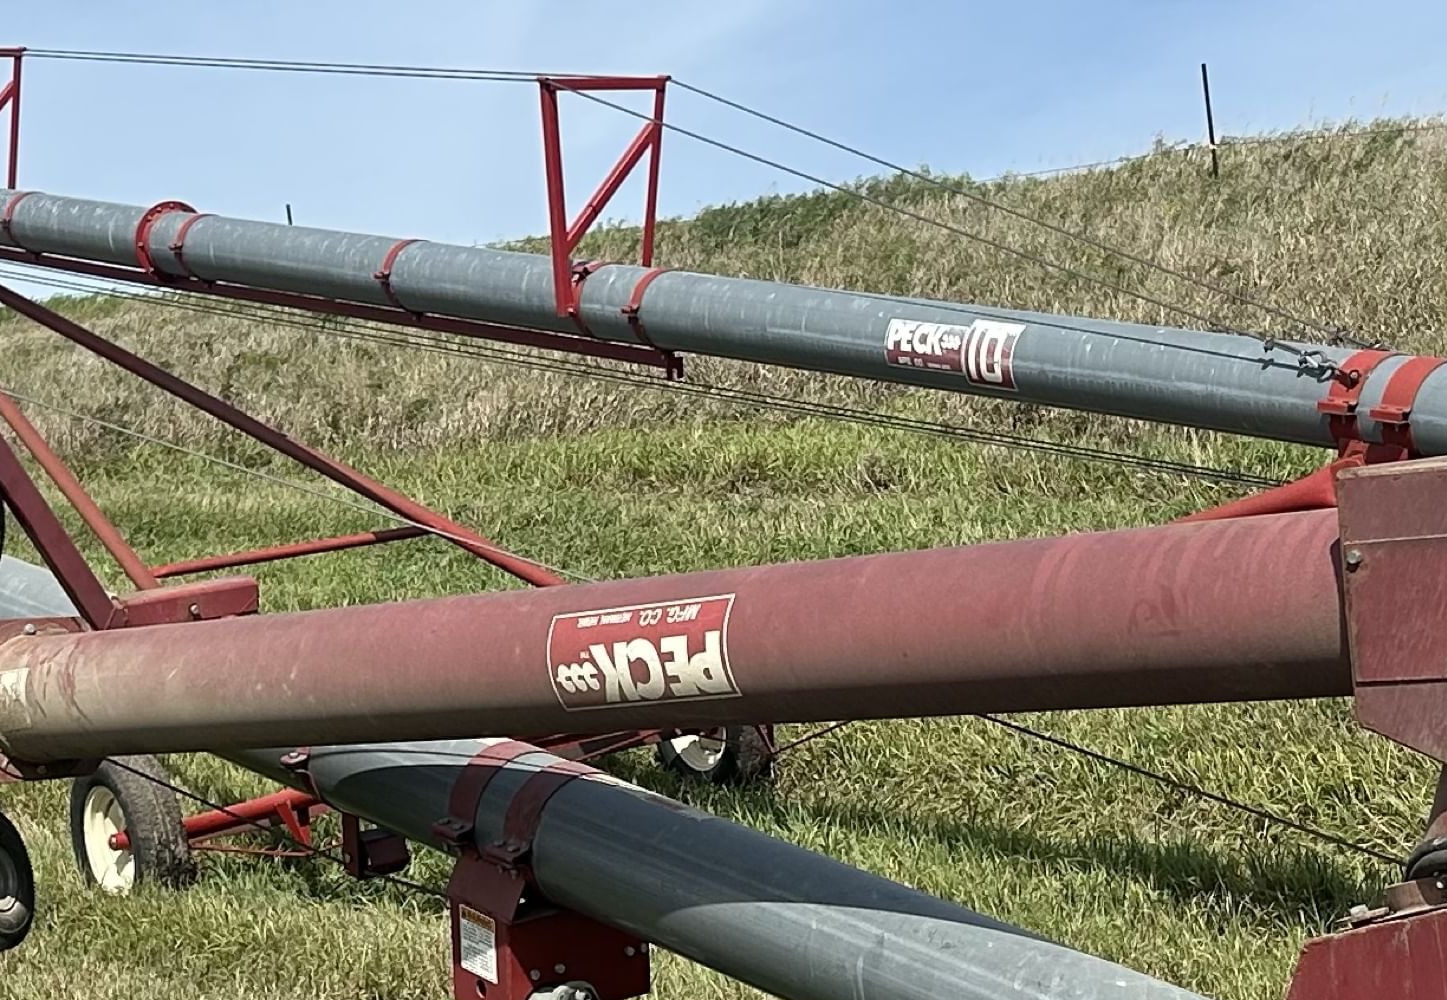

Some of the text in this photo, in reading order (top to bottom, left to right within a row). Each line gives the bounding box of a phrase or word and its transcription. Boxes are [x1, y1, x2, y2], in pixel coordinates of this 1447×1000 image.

[888, 321, 945, 356] PECK
[639, 609, 663, 627] CO.
[667, 604, 702, 624] MFG.
[589, 630, 733, 703] PECK
